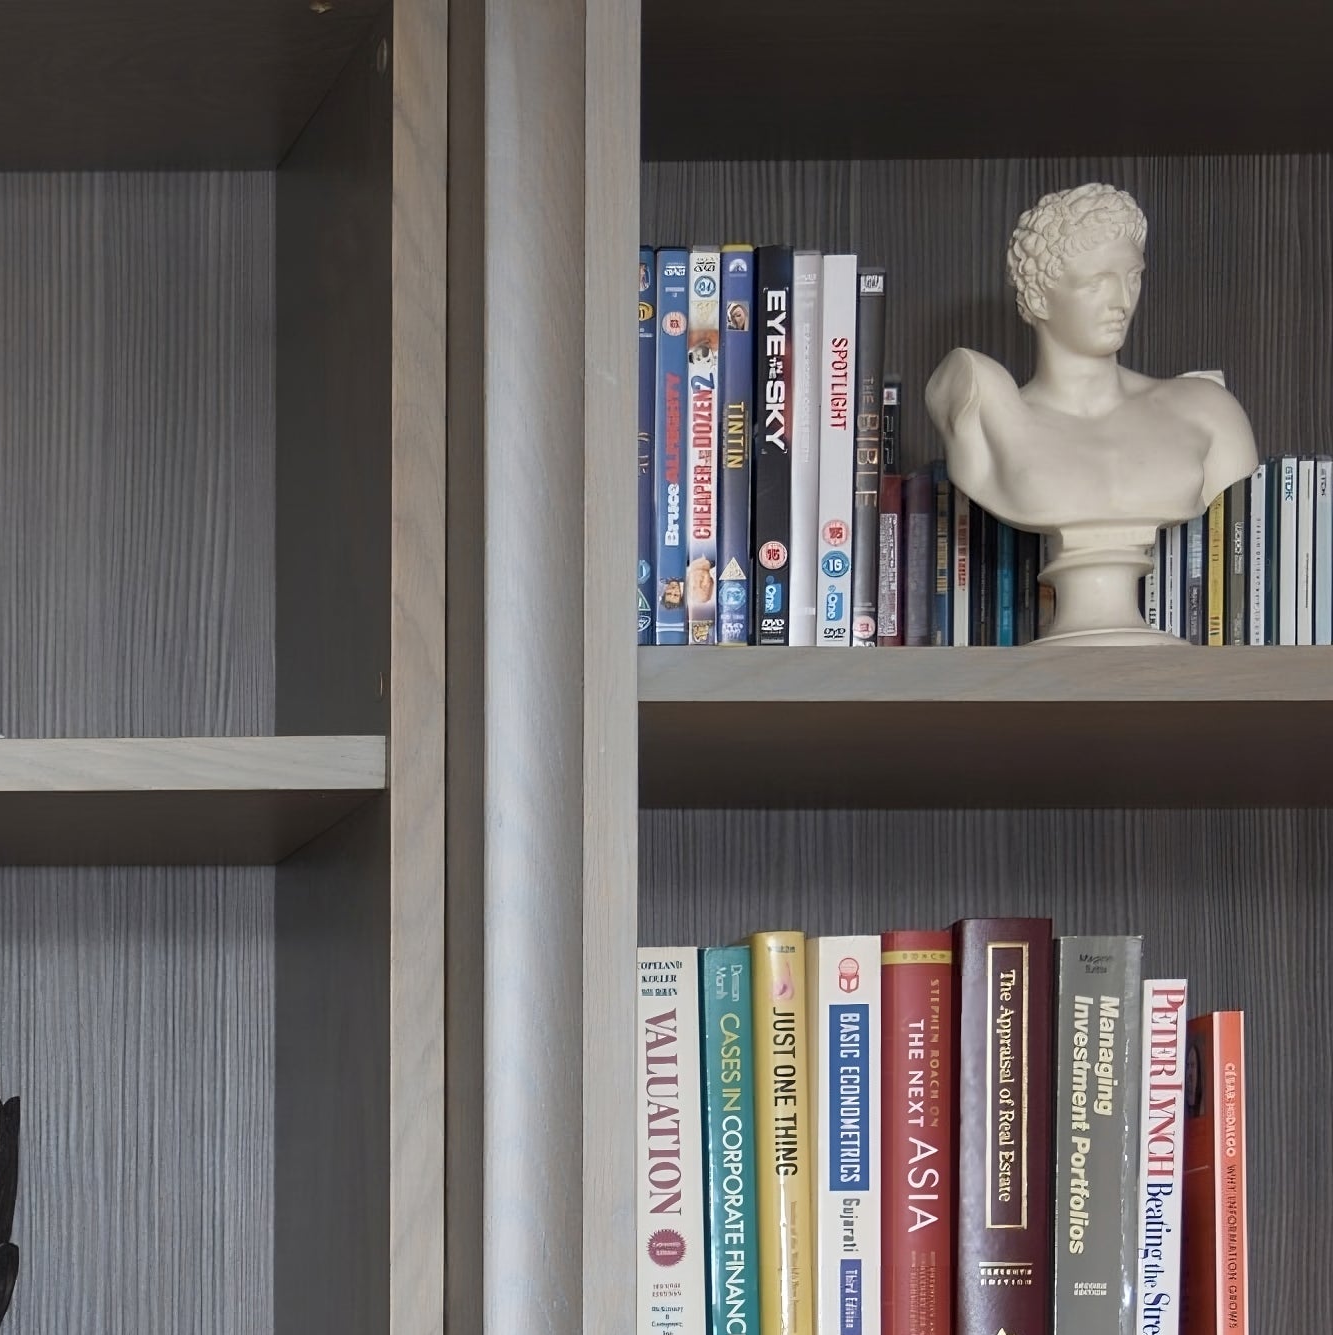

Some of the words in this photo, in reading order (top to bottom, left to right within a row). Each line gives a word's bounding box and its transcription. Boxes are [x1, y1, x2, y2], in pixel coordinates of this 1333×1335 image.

[766, 290, 786, 356] EYE
[691, 373, 715, 391] 2
[830, 337, 848, 431] SPOTLIGHT
[862, 376, 875, 404] THE
[691, 387, 713, 448] DOZEN
[727, 401, 745, 469] TINTIN
[765, 380, 786, 451] SKY
[856, 413, 880, 507] BIBLE
[665, 484, 680, 546] Bruce
[693, 466, 712, 540] CHEAPER
[929, 978, 940, 1043] STEPHEN
[999, 969, 1016, 1002] The
[720, 1012, 742, 1084] CASES
[772, 1006, 796, 1059] JUST
[839, 1012, 861, 1059] BASIC
[908, 1018, 925, 1061] THE
[996, 1004, 1015, 1084] Appraisal
[1071, 995, 1094, 1131] Investment
[1093, 994, 1121, 1116] Managing
[1149, 986, 1186, 1077] PETER
[721, 1087, 742, 1112] IN
[773, 1064, 797, 1107] ONE
[907, 1070, 925, 1128] NEXT
[929, 1050, 940, 1099] ROACH
[998, 1087, 1015, 1107] of
[644, 1007, 683, 1216] VALUATION
[839, 1065, 861, 1183] ECONOMETRICS
[929, 1105, 940, 1128] ON
[998, 1109, 1015, 1146] Real
[1147, 1081, 1183, 1178] LYNCH
[774, 1112, 799, 1176] THING
[998, 1149, 1015, 1203] Estate
[722, 1115, 745, 1245] CORPORATE
[907, 1136, 940, 1233] ASIA
[1068, 1134, 1091, 1254] Portfolios
[839, 1197, 861, 1253] Gujarati
[1140, 1183, 1174, 1261] Beating
[1144, 1263, 1165, 1288] the
